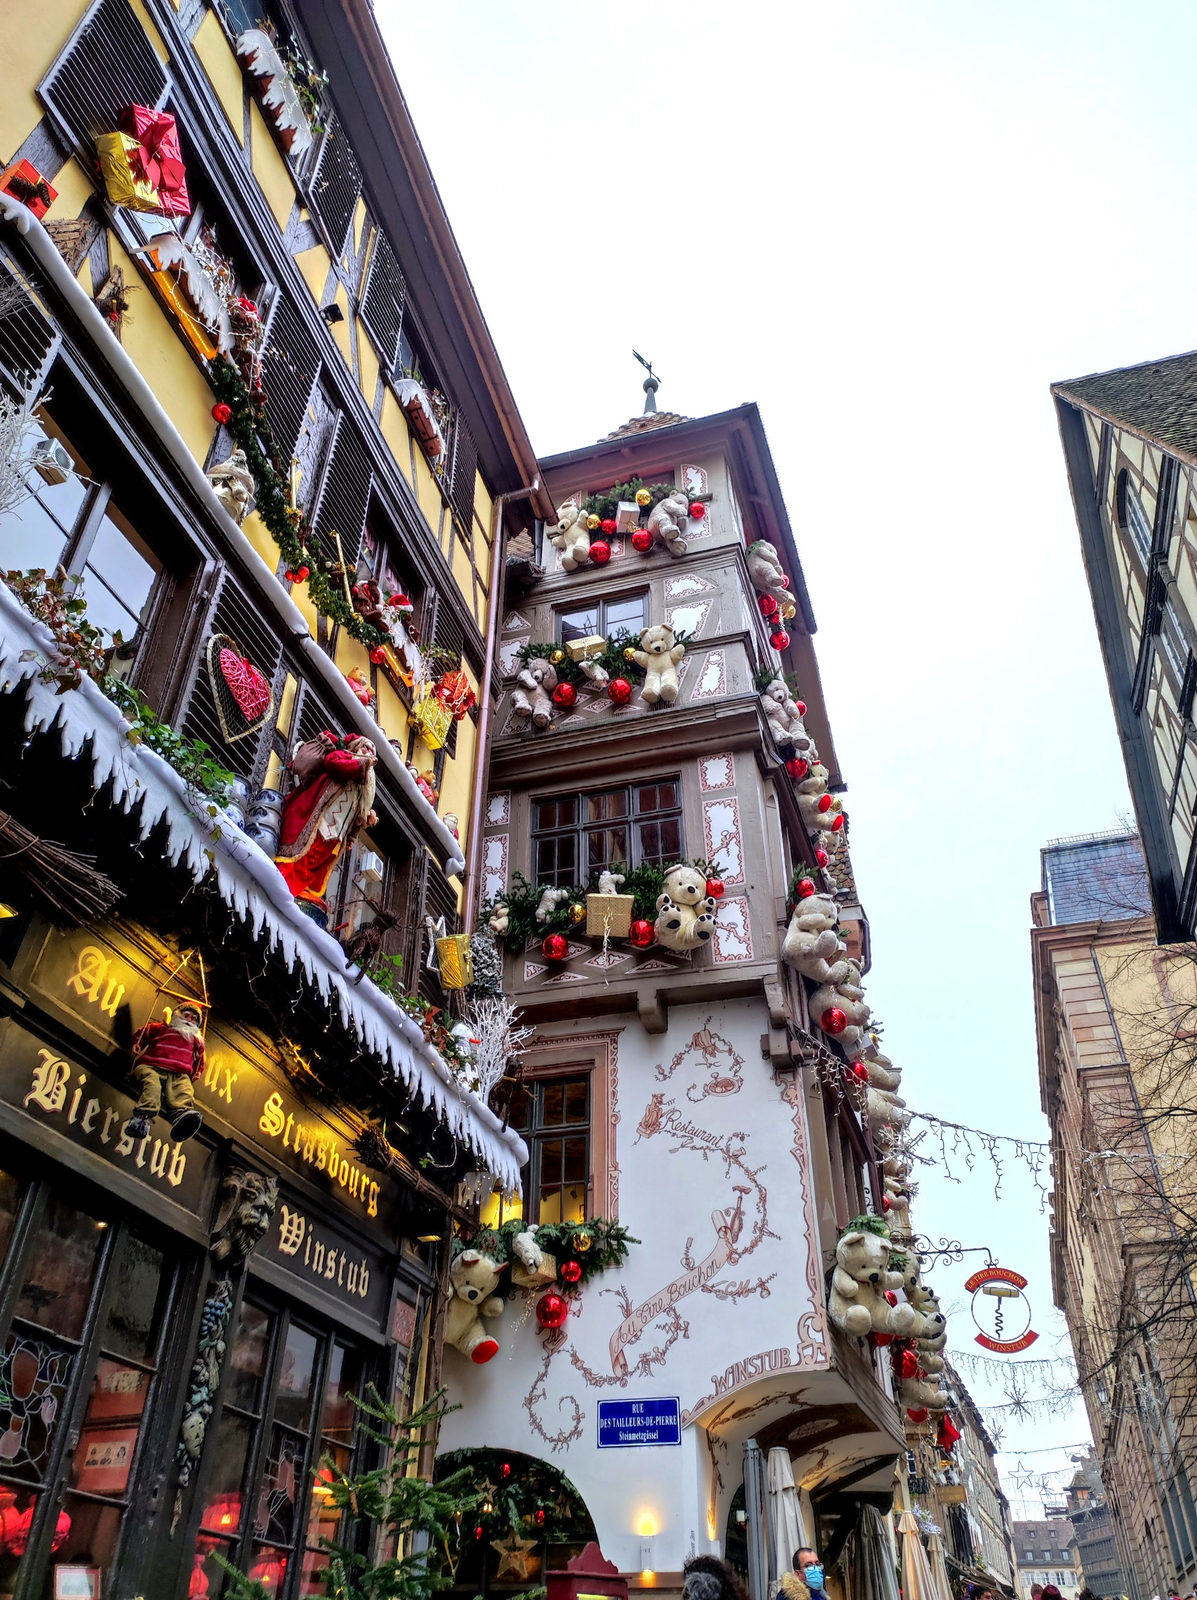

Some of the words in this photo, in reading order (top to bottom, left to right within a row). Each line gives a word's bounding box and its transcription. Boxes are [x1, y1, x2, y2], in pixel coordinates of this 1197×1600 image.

[66, 945, 126, 1018] Au
[258, 1090, 381, 1219] Strasbourg
[24, 1048, 187, 1187] Bierstub
[661, 1109, 724, 1148] Restaurant
[278, 1204, 371, 1298] Winstub
[967, 1280, 975, 1289] LE
[974, 1272, 988, 1281] TIRE
[989, 1270, 1025, 1285] BOUCHON
[614, 1325, 637, 1353] Au
[667, 1258, 721, 1306] Bouchon
[989, 1340, 1027, 1351] WINSTUB
[711, 1347, 790, 1394] WINSTUB
[600, 1418, 612, 1429] DES
[612, 1415, 677, 1428] TAILLEURS-DE-PIERRE
[631, 1403, 645, 1414] RUE
